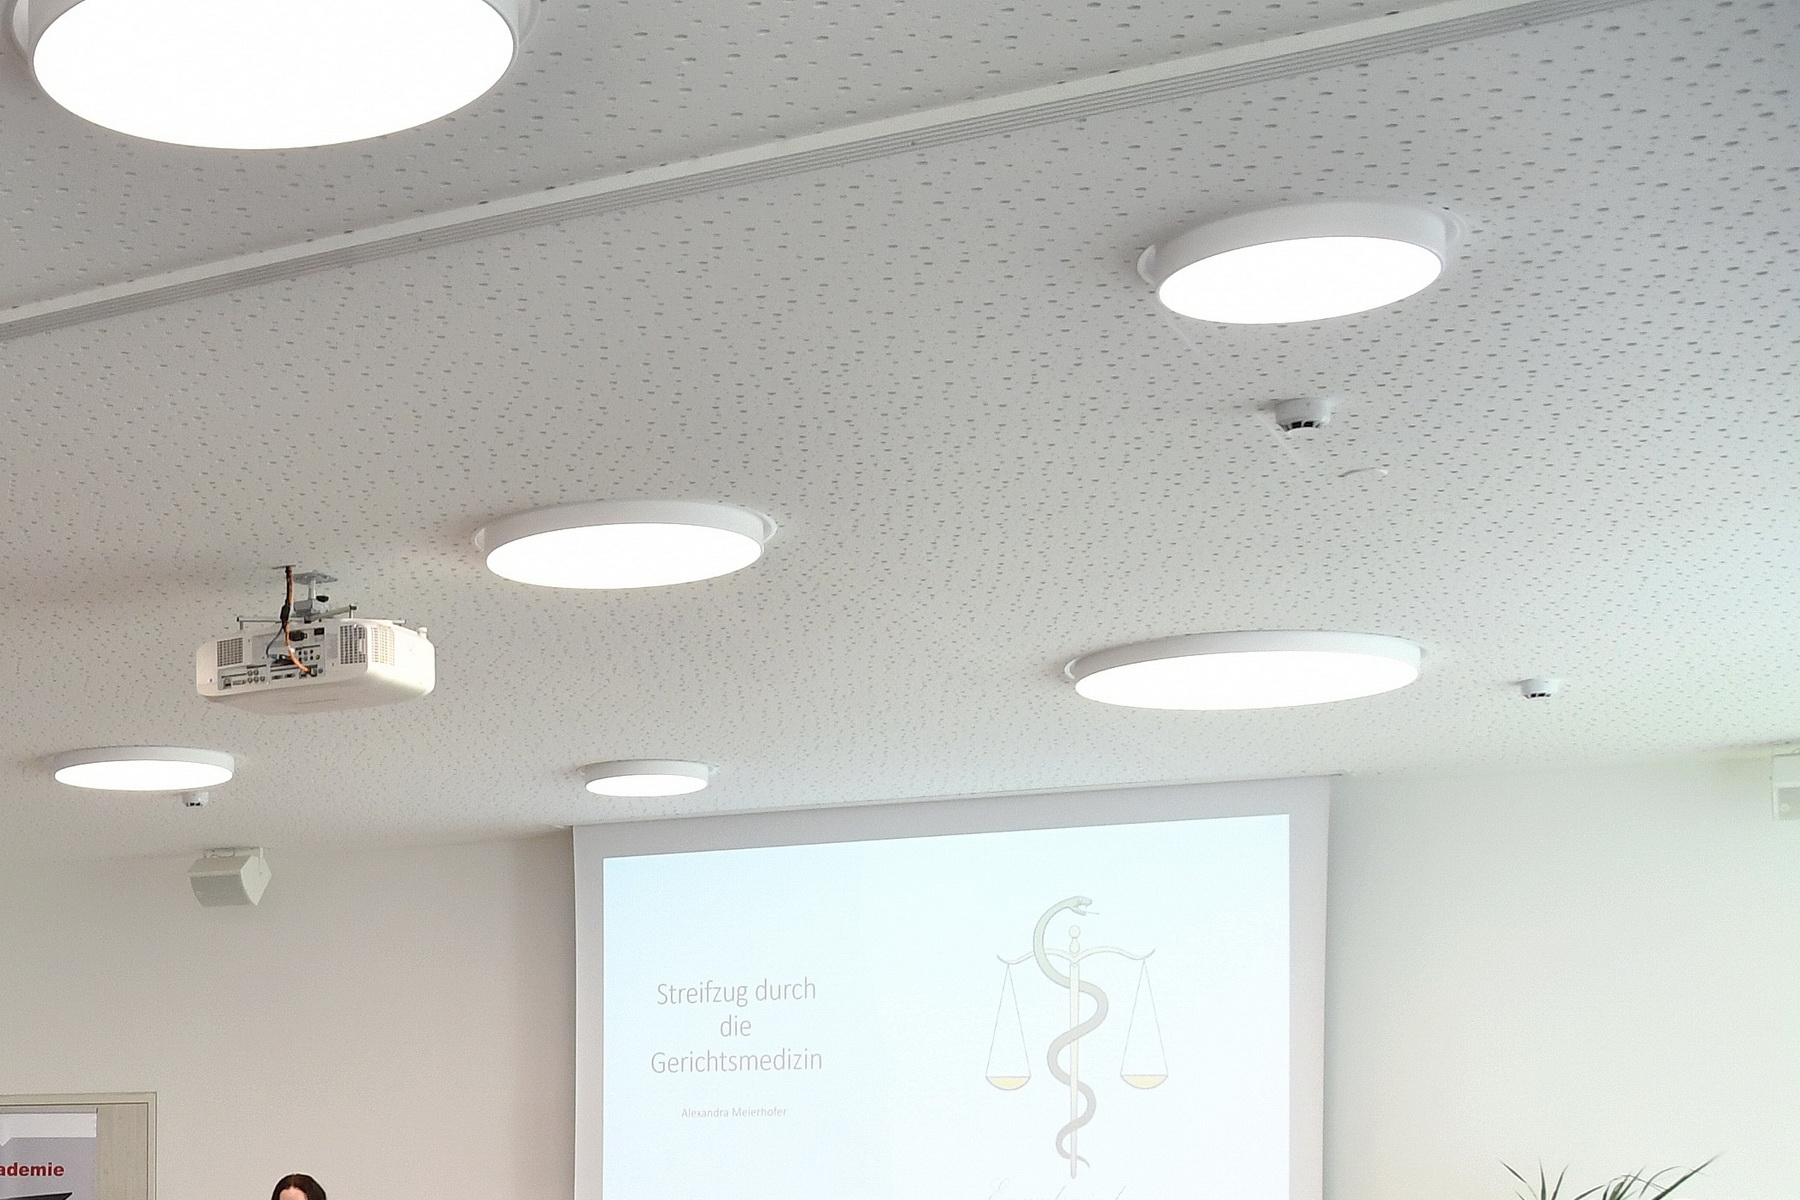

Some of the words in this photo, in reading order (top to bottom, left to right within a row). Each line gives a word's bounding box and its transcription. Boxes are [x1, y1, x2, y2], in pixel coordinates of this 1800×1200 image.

[657, 980, 748, 1007] Streifzug
[755, 976, 816, 1001] durch
[720, 1014, 752, 1037] die
[651, 1047, 822, 1073] Gerichtsmedizin
[681, 1108, 729, 1118] Alexandra
[732, 1106, 787, 1117] Meierhofer
